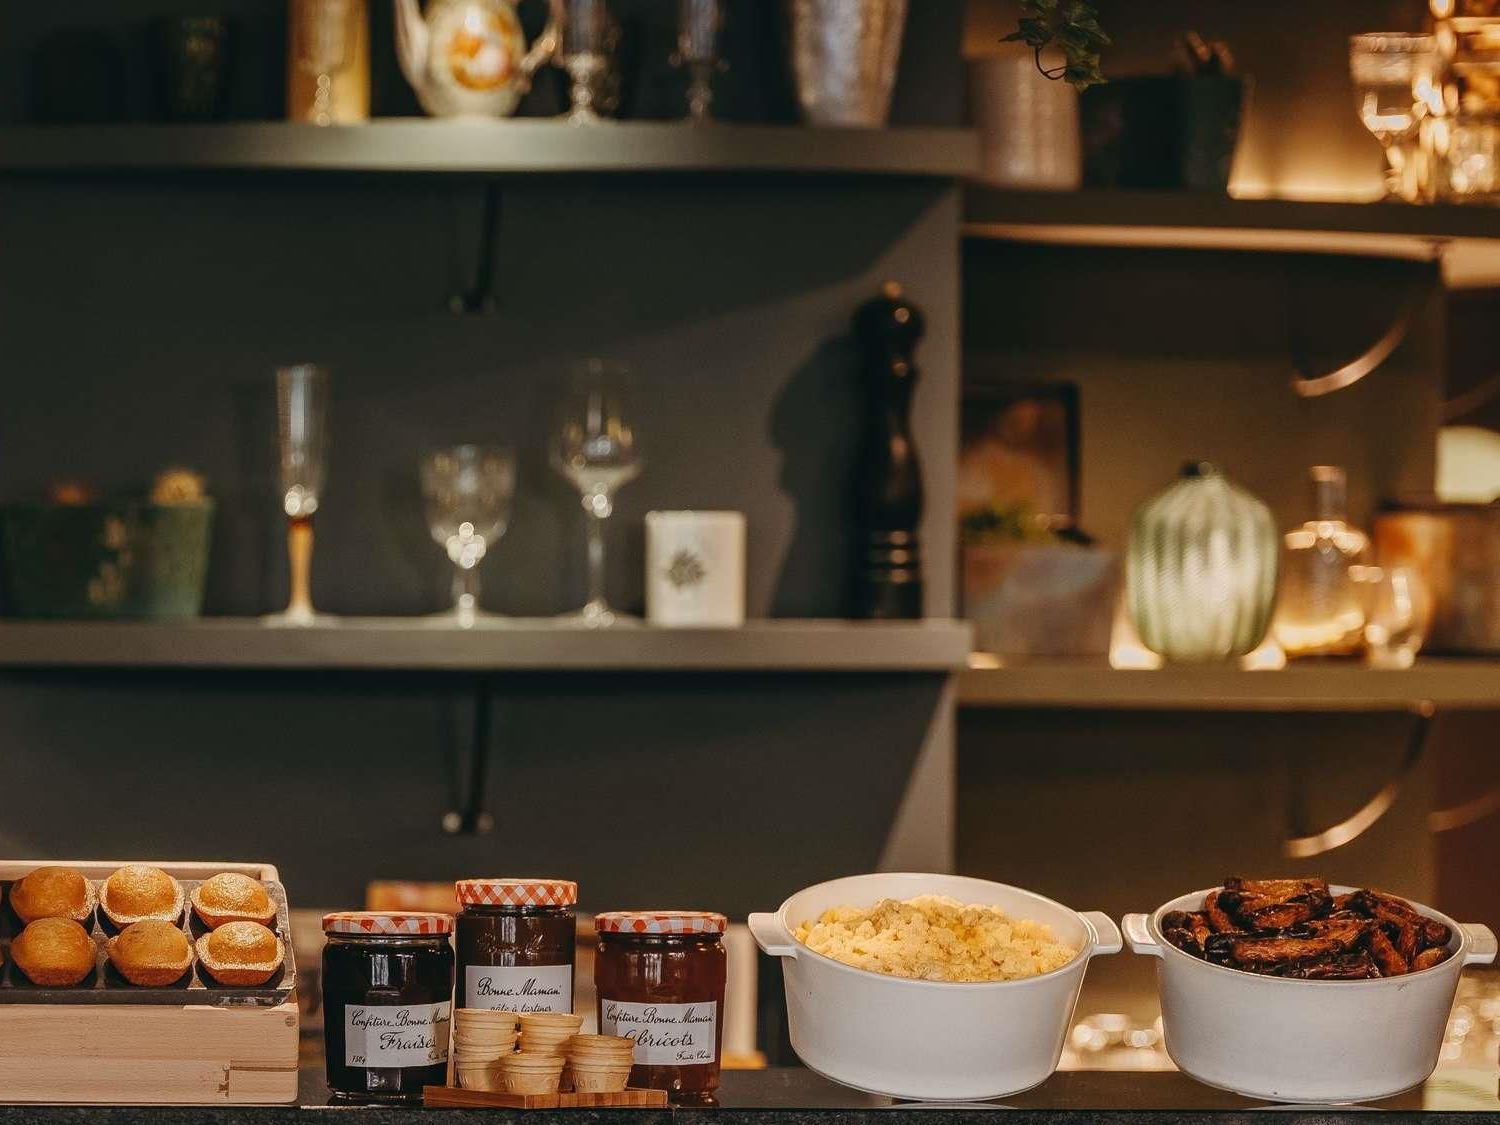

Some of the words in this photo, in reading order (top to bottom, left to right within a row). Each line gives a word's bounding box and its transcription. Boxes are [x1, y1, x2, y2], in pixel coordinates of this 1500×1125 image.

[477, 976, 514, 997] Bonne
[515, 978, 562, 997] Maman
[351, 1009, 395, 1030] Confiture
[395, 1009, 428, 1027] Bonne
[606, 1002, 641, 1025] Confiture
[642, 1007, 677, 1024] Bonne
[678, 1005, 714, 1024] Maman
[380, 1030, 436, 1050] Fraises
